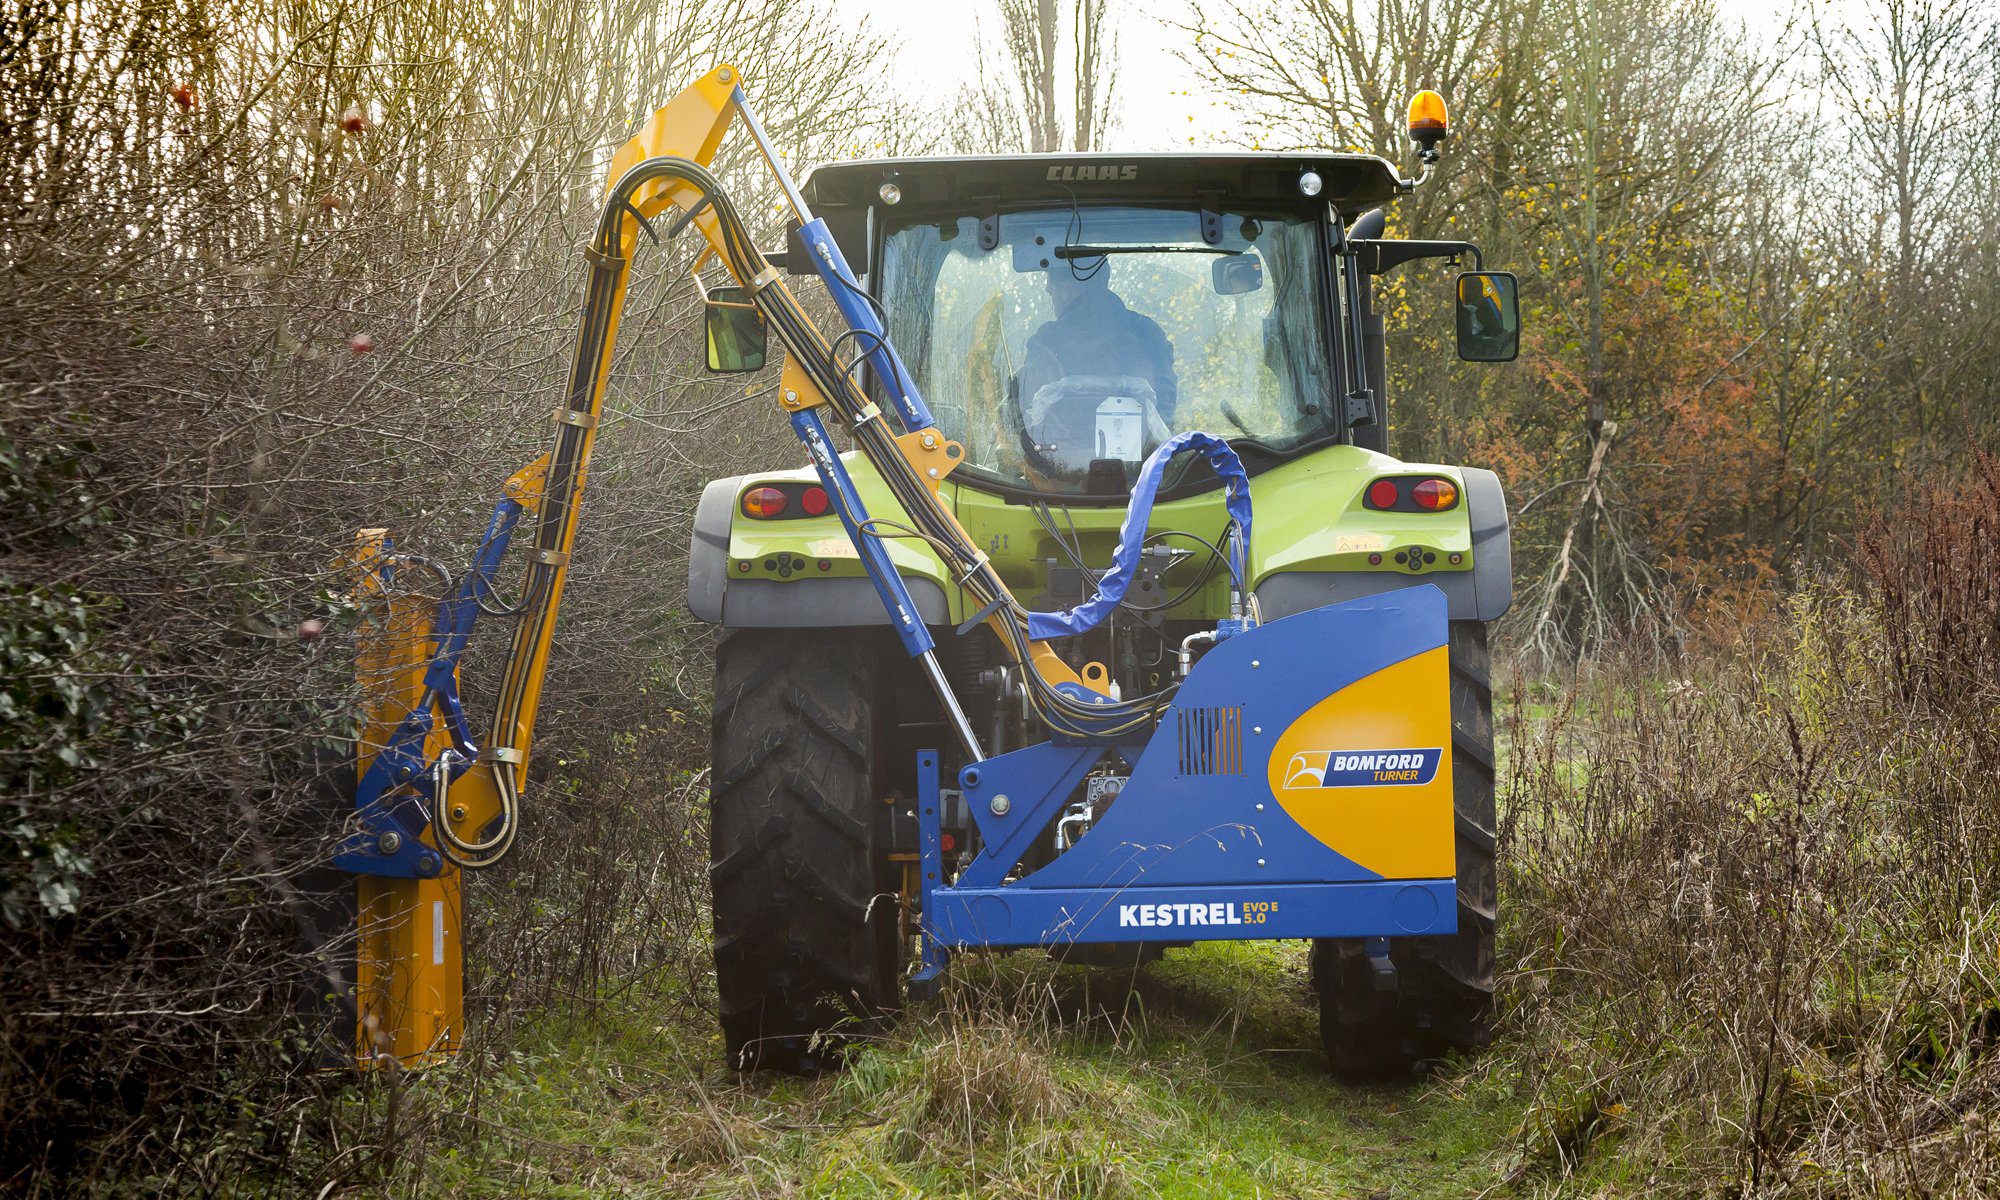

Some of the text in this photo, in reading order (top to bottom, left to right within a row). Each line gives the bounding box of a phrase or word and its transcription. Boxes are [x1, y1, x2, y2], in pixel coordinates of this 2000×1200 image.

[1046, 165, 1138, 181] CLAAS
[1333, 753, 1424, 772] BOMFORD
[1373, 770, 1419, 782] TURNER
[1243, 901, 1279, 913] EVO E
[1119, 902, 1242, 927] KESTREL
[1243, 913, 1266, 924] 5.0
